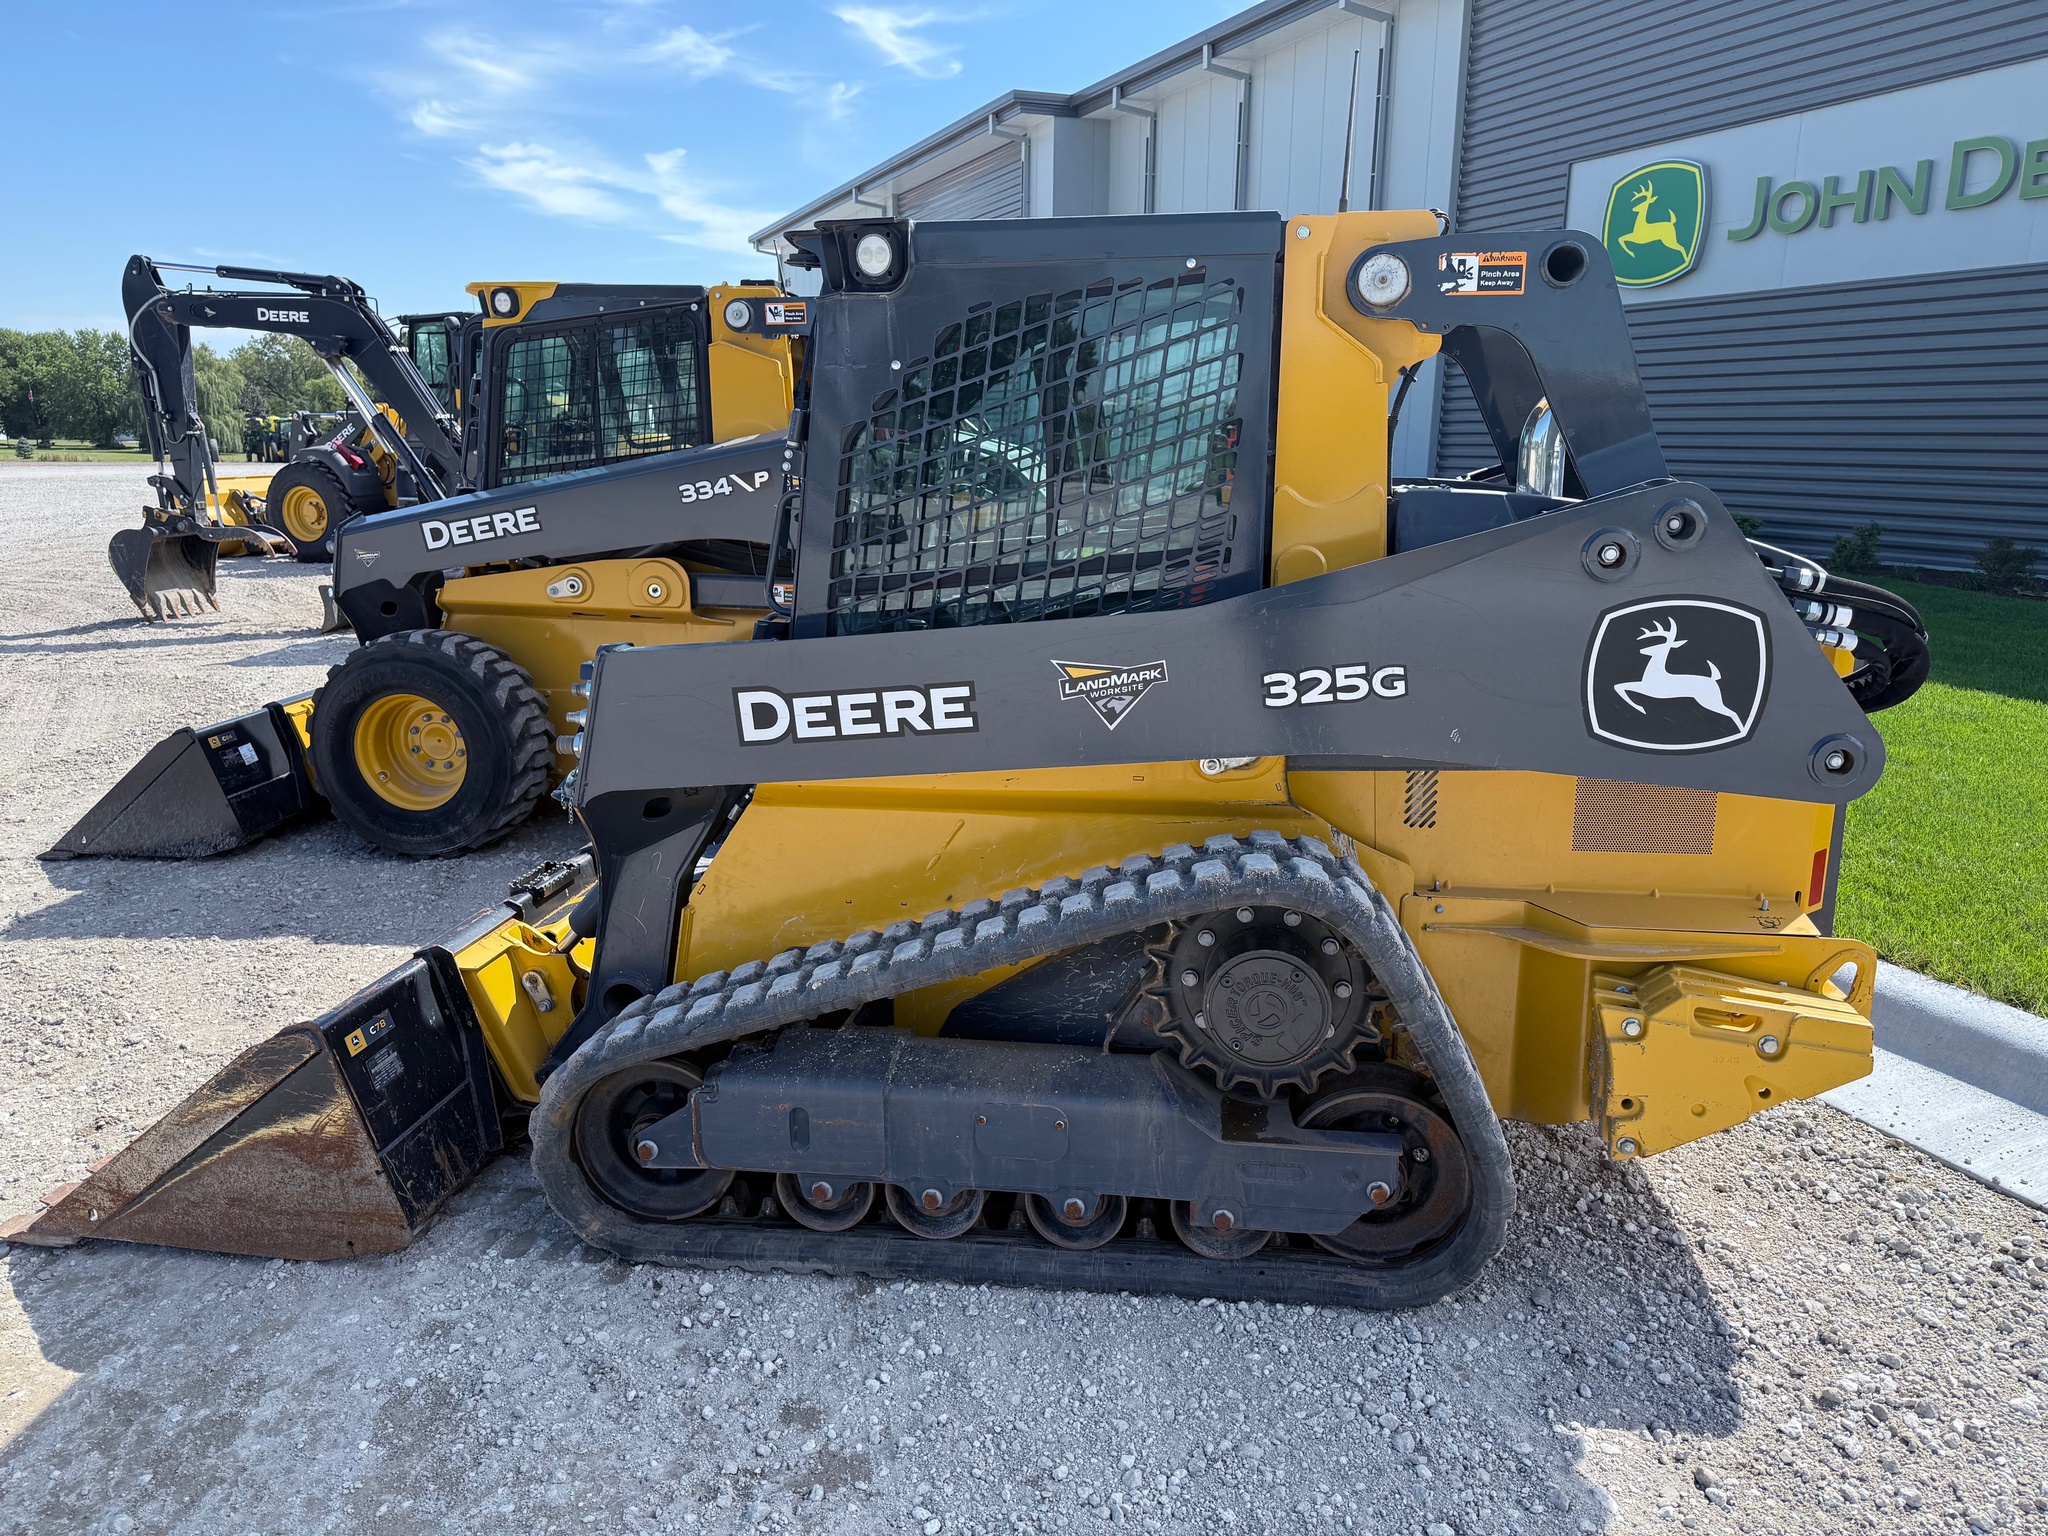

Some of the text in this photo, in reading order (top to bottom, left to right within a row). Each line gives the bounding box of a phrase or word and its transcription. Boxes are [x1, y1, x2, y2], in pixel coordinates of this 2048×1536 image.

[1727, 158, 1934, 242] JOHN
[1480, 270, 1502, 278] Pinch
[256, 307, 310, 323] DEERE
[421, 507, 541, 550] DEERE
[1064, 668, 1162, 694] LANDMARK
[1089, 682, 1144, 698] WORKSITE
[1262, 665, 1407, 707] 325G
[737, 686, 974, 742] DEERE
[369, 1019, 387, 1035] C78
[1225, 996, 1263, 1046] SPICER
